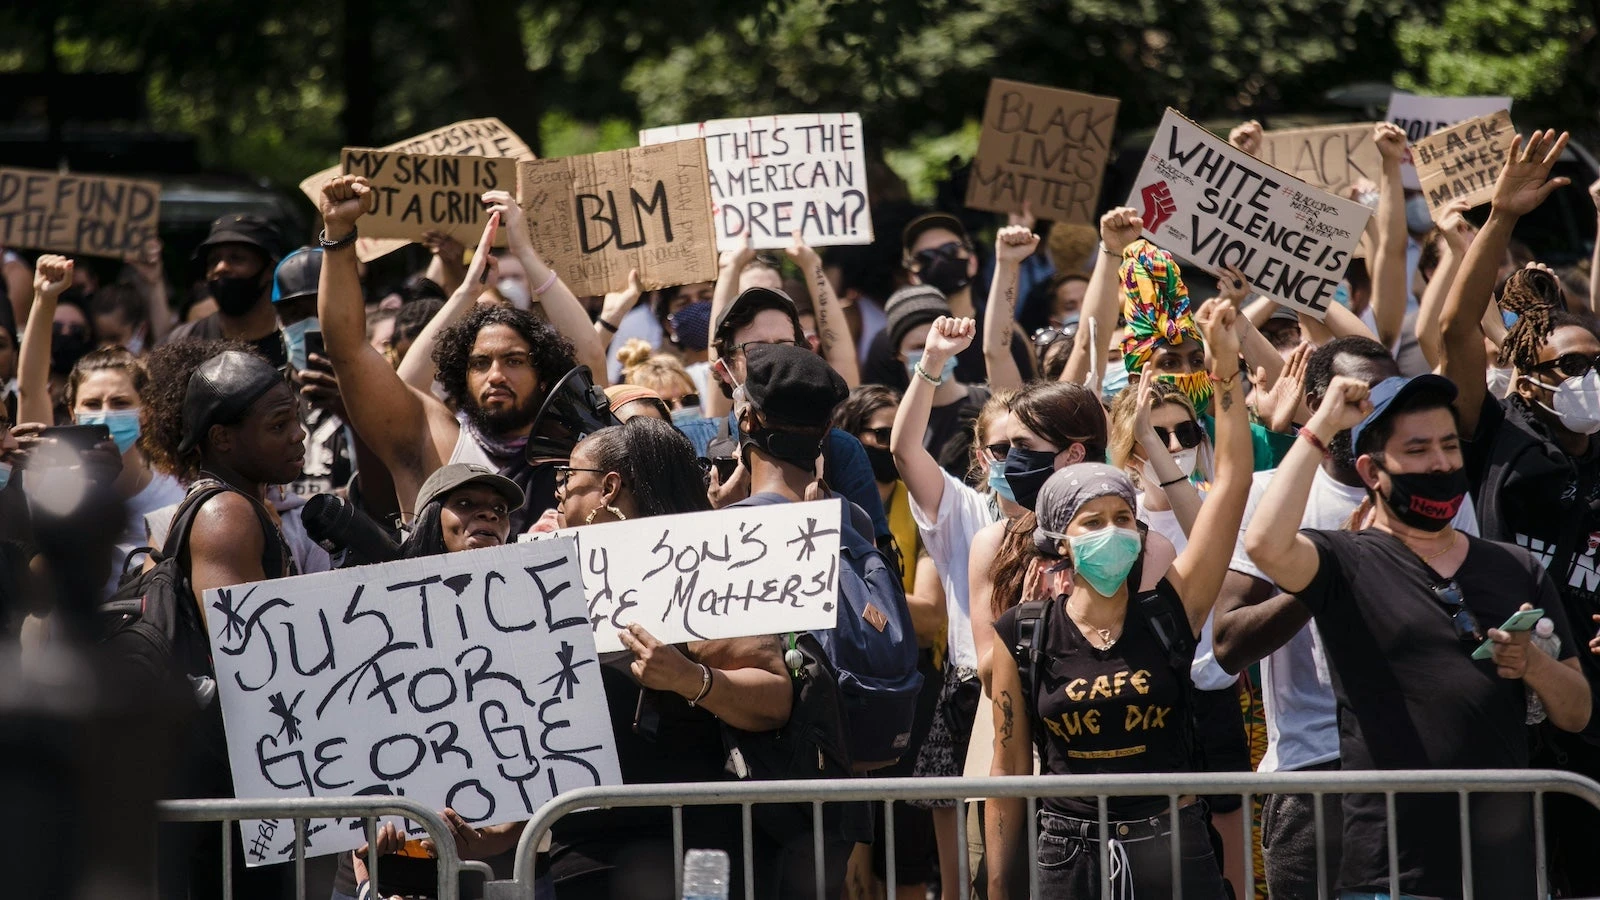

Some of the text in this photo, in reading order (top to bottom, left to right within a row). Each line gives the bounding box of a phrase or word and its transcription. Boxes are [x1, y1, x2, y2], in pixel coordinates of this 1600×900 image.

[706, 124, 855, 162] THIS THE
[990, 91, 1113, 149] BLACK
[1420, 117, 1504, 164] BLACK
[346, 152, 498, 189] MY SKIN IS
[708, 161, 853, 198] AMERICAN
[1007, 134, 1097, 180] LIVES
[1169, 125, 1281, 212] WHITE
[1441, 141, 1504, 177] LIVES
[368, 187, 399, 217] OT
[402, 193, 422, 225] A
[722, 190, 866, 239] DREAM?
[972, 162, 1096, 220] MATTER
[0, 205, 73, 248] THE
[576, 179, 674, 254] BLM
[1197, 188, 1348, 272] SILENCE IS
[1191, 214, 1339, 313] VIOLENCE
[221, 556, 588, 692] JUSTICE
[317, 643, 536, 720] FOR
[1065, 669, 1152, 702] CAFE
[1125, 704, 1171, 732] DIX
[257, 697, 603, 797] GEORGE
